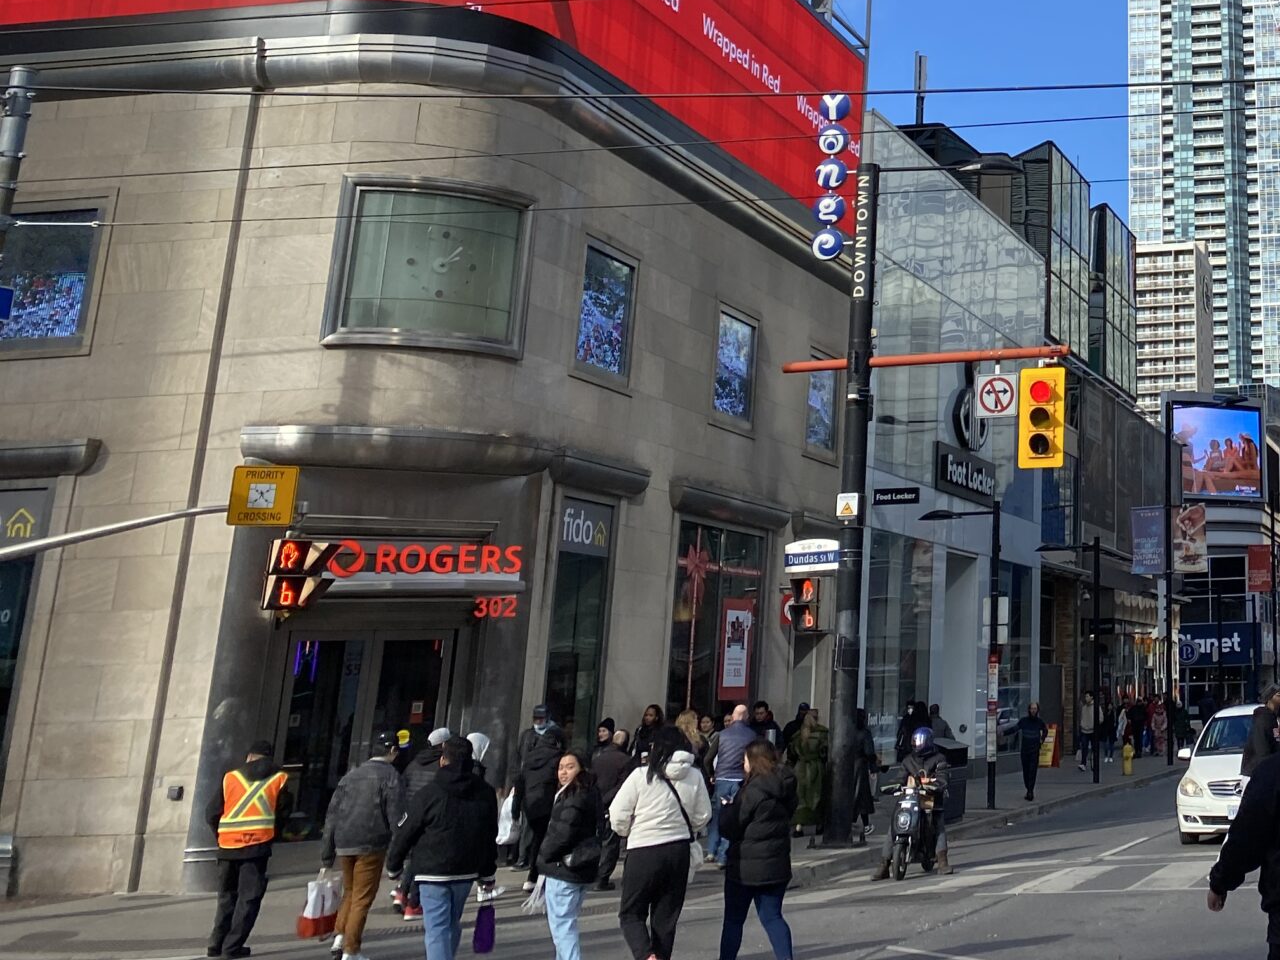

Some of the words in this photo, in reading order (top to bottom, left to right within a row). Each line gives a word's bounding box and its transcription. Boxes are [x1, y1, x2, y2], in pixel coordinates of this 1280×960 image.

[702, 12, 751, 70] Wrapped
[751, 54, 761, 79] in
[762, 65, 780, 94] Red
[853, 174, 870, 298] DOWNTOWN
[245, 470, 285, 481] PRIORITY
[947, 453, 967, 487] Foot
[968, 462, 995, 497] Locker
[875, 493, 892, 501] Foot
[892, 492, 916, 500] Locker
[237, 511, 281, 522] CROSSING
[563, 508, 593, 545] fido
[375, 543, 523, 575] ROGERS
[788, 553, 818, 565] Dundas
[827, 551, 835, 562] W
[473, 596, 516, 619] 302
